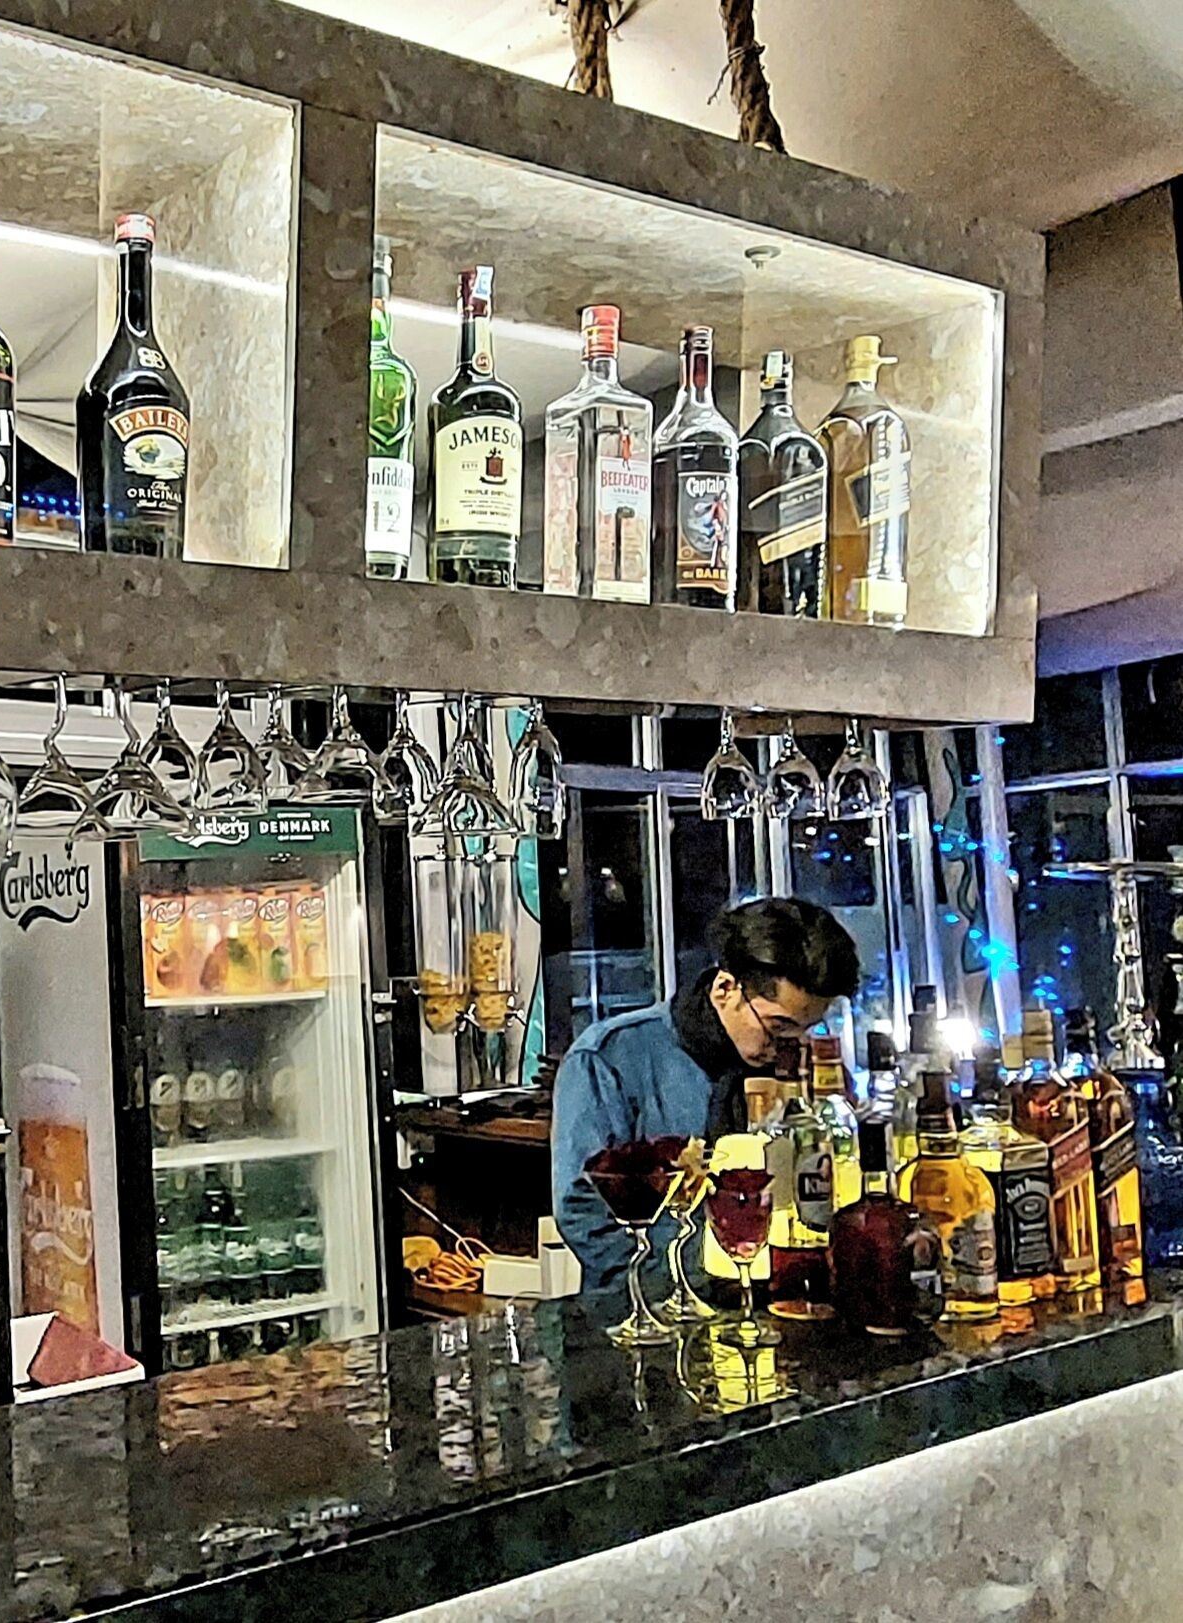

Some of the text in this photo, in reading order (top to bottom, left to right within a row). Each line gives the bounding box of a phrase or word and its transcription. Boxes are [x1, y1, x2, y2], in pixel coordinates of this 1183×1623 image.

[118, 408, 188, 437] BAILEYS
[449, 426, 519, 450] JAMESO
[601, 470, 649, 491] BEEFEATER
[127, 488, 183, 504] ORIGINAL
[259, 820, 331, 834] DENMARK
[0, 851, 89, 920] Carlsberg
